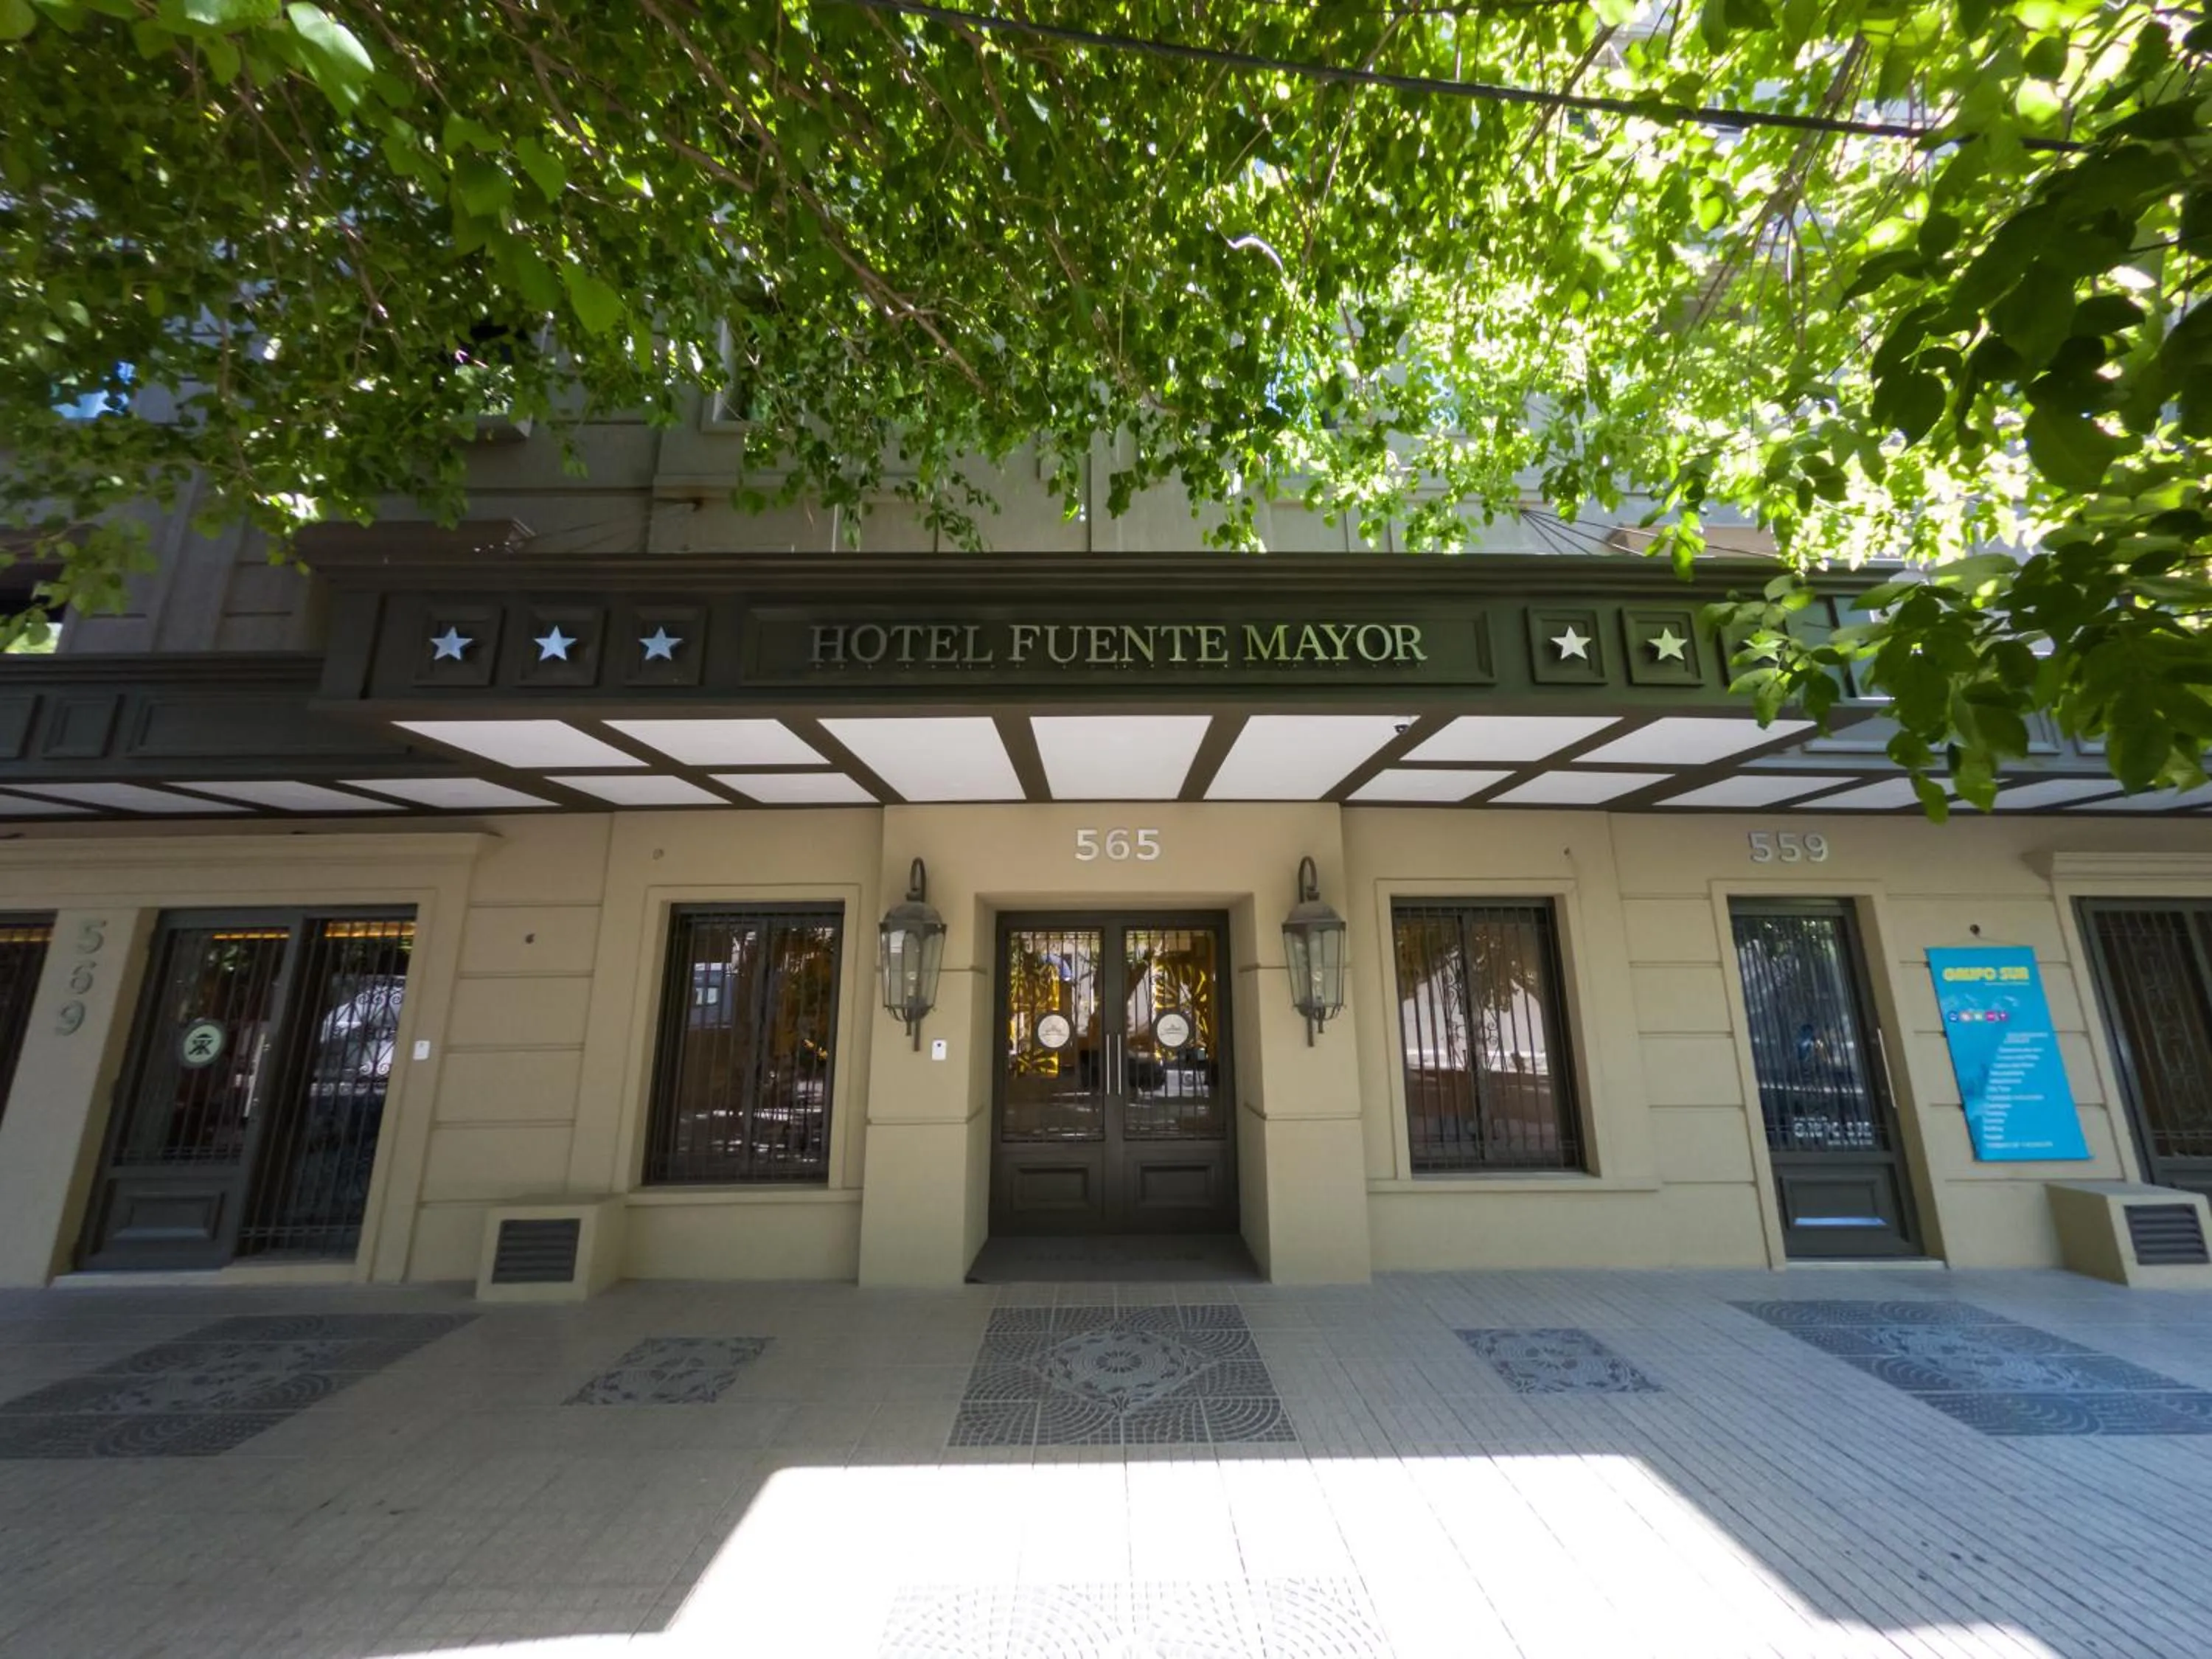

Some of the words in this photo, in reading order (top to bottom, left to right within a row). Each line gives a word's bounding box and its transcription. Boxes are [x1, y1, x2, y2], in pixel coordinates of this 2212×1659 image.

[810, 625, 993, 663] HOTEL
[1009, 625, 1228, 663] FUENTE
[1242, 624, 1428, 662] MAYOR
[1074, 828, 1161, 861] 565
[1747, 831, 1829, 863] 559
[54, 919, 106, 1037] 569
